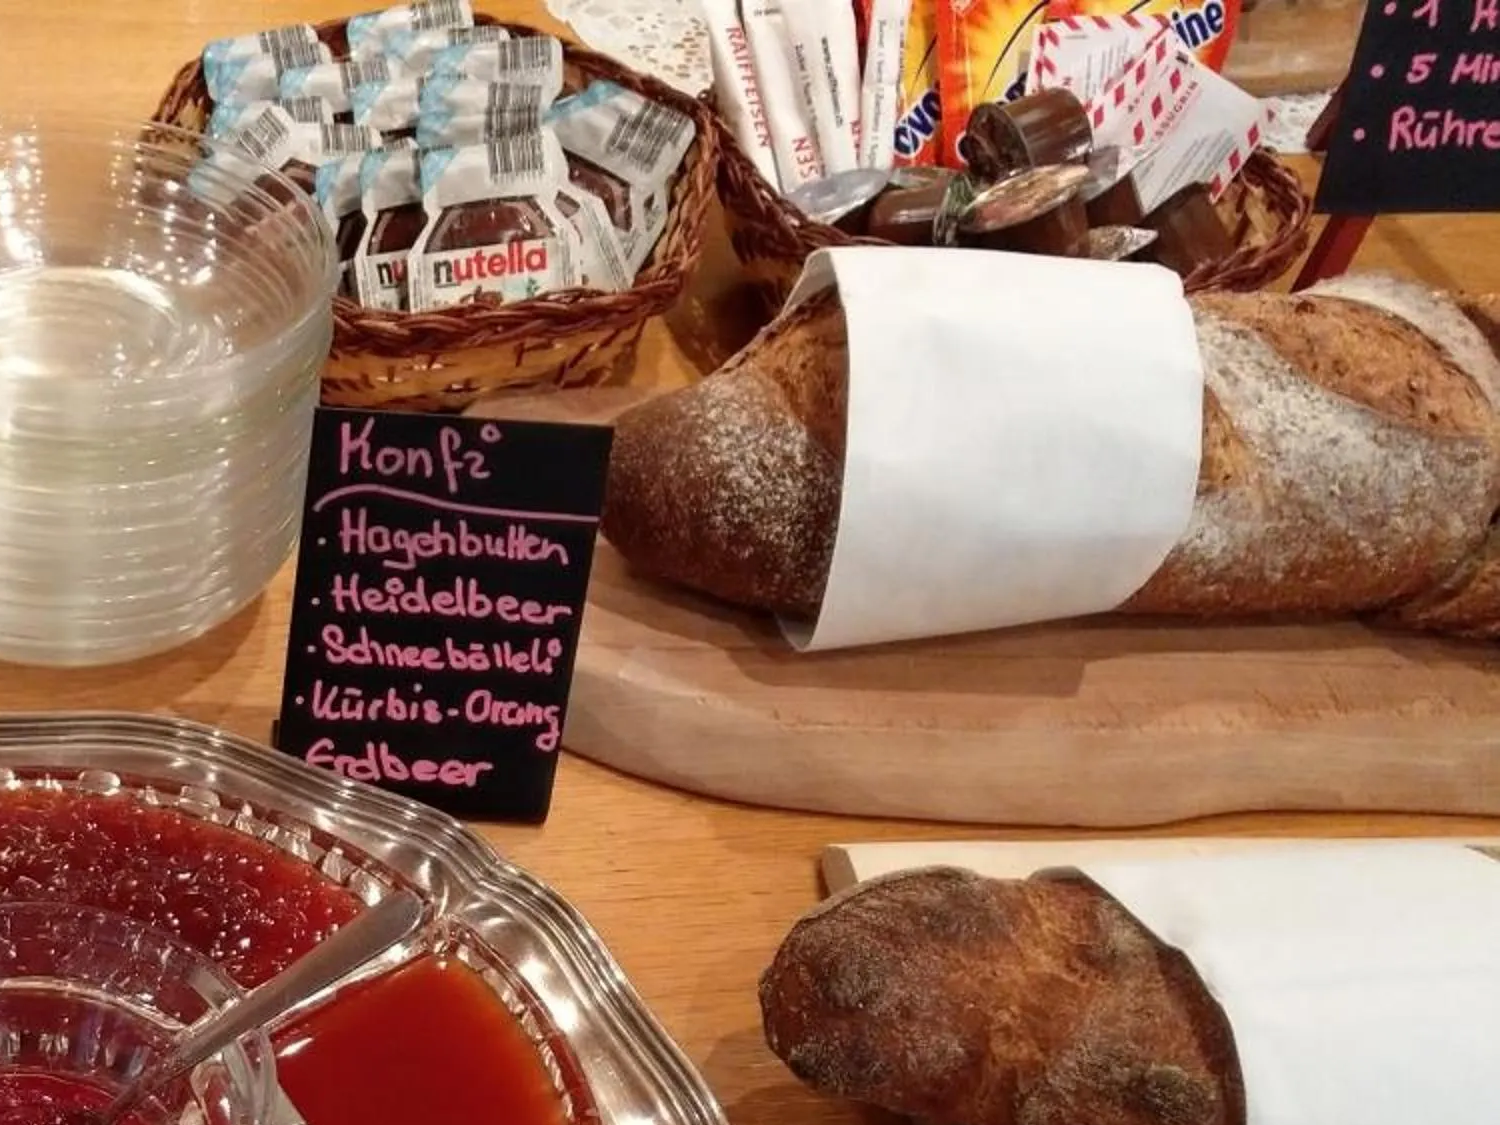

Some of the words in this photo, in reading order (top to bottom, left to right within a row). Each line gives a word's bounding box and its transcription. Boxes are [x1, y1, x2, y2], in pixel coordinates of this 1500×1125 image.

[725, 26, 772, 148] RAIFFEISEN
[1406, 53, 1437, 83] 5
[434, 240, 547, 287] nutella
[339, 416, 503, 494] Konfi
[330, 573, 573, 625] Heidelbeer
[305, 737, 494, 788] Erdbeer
